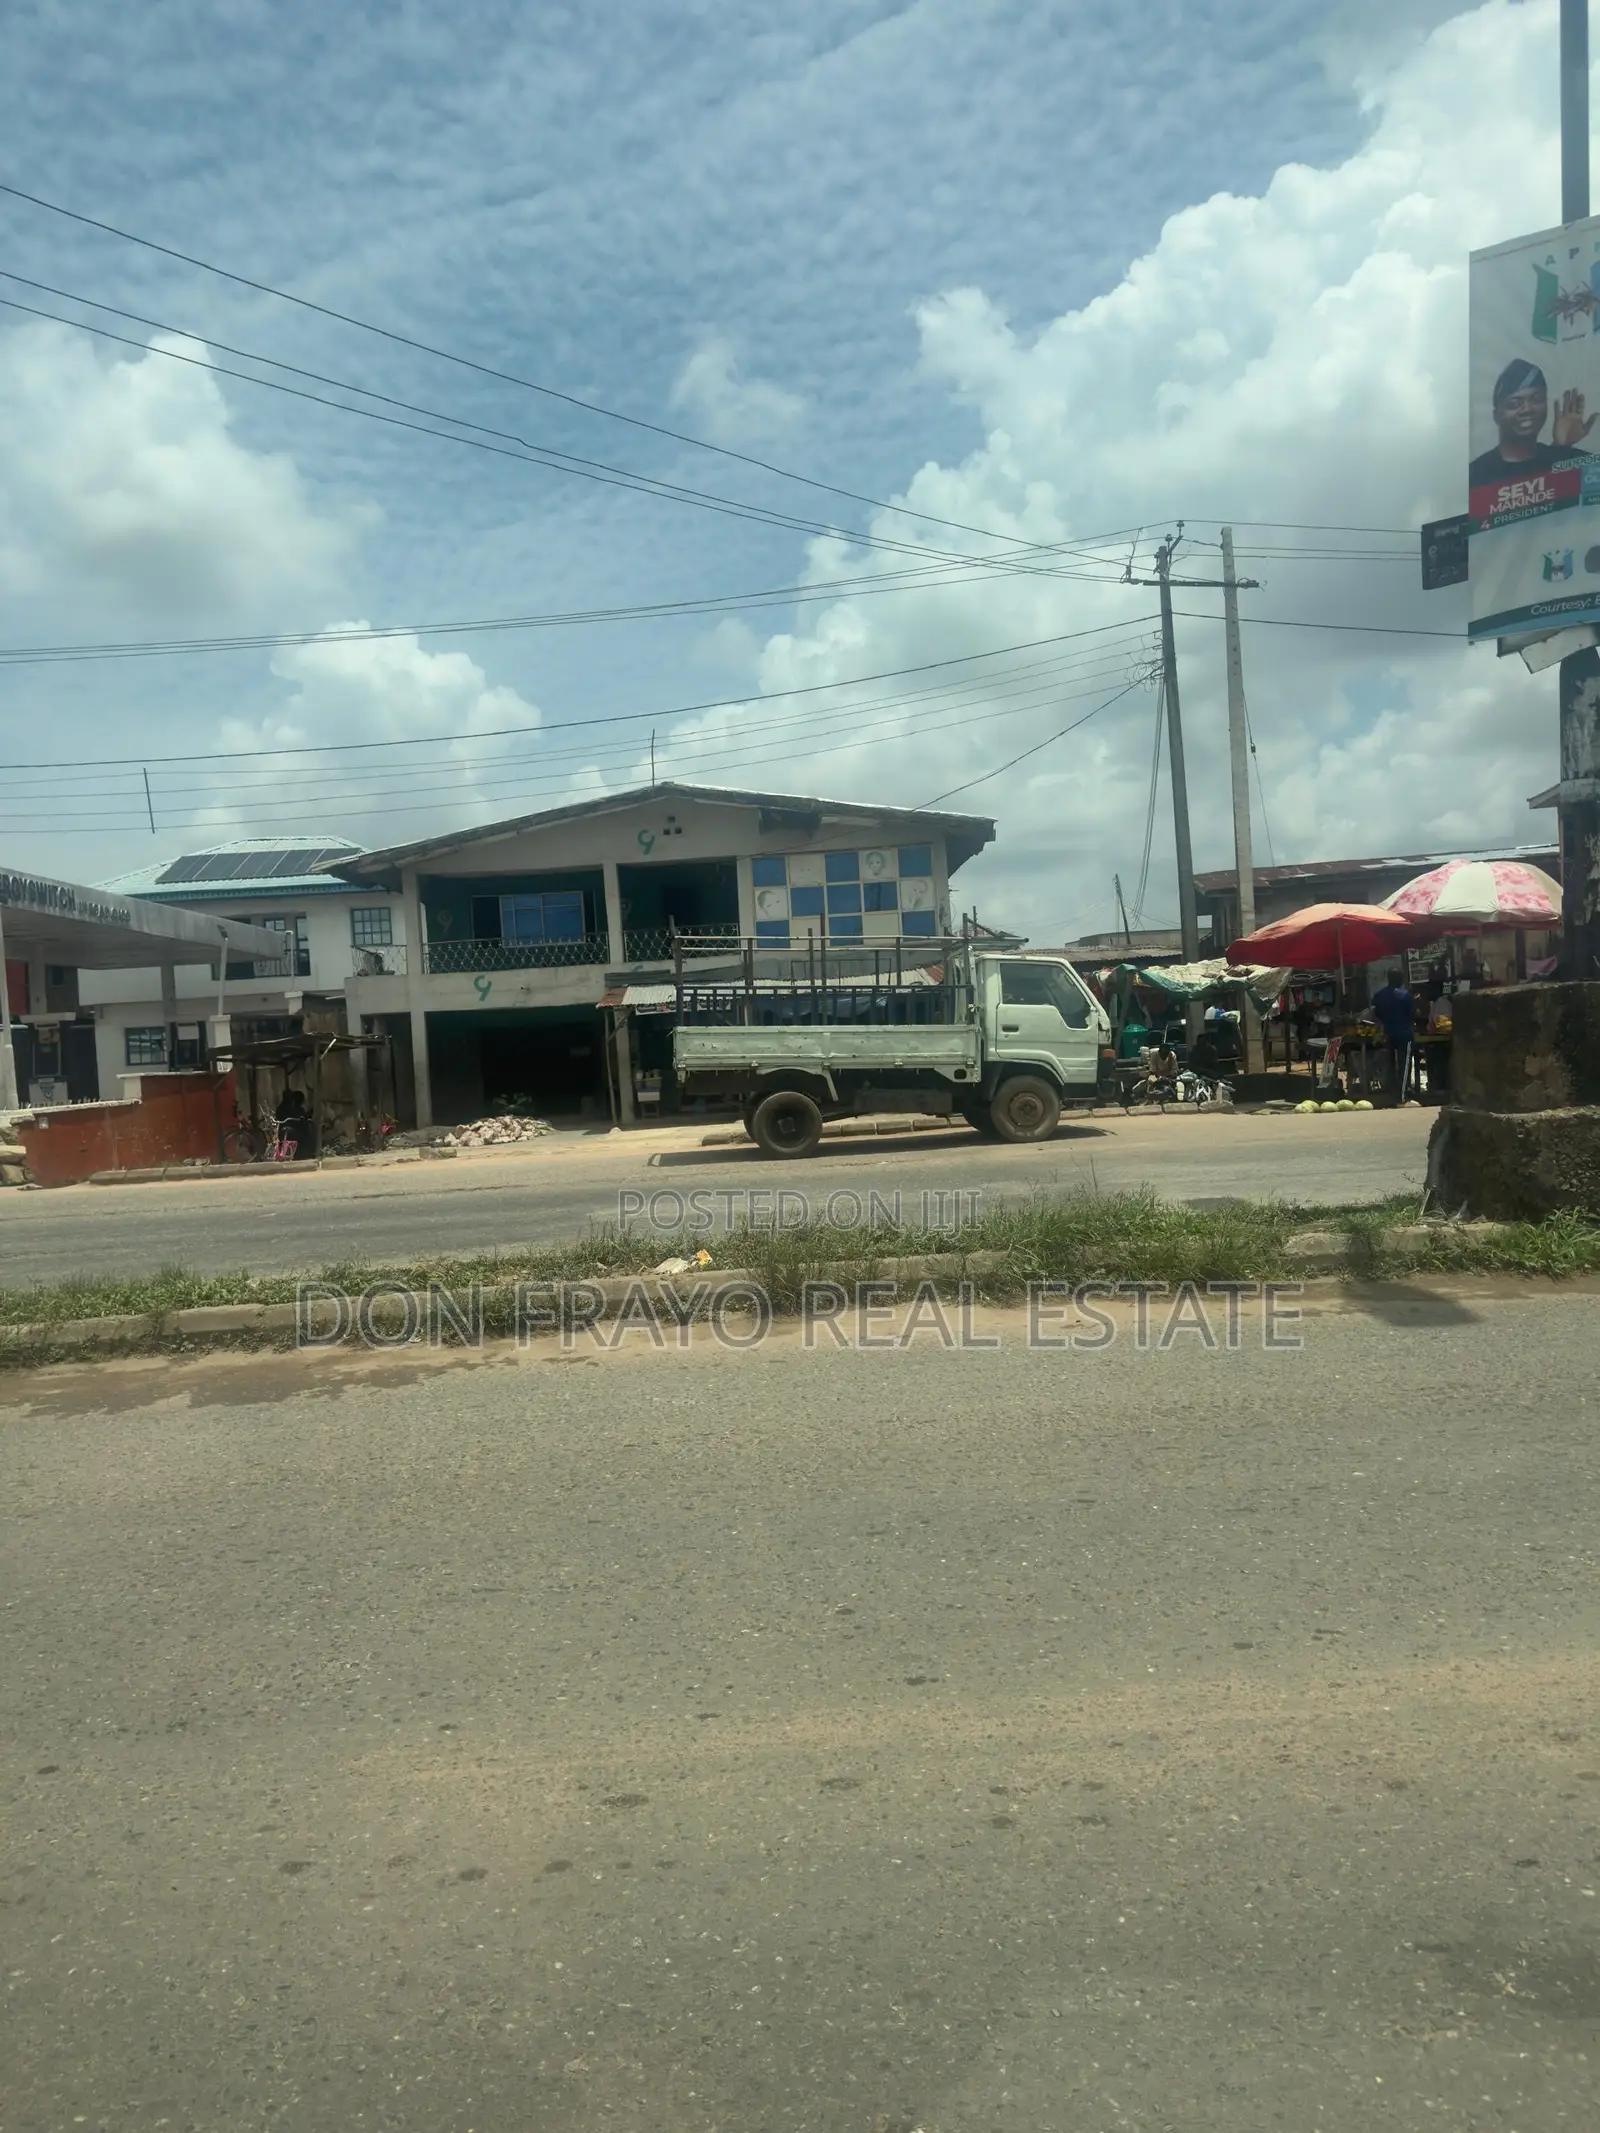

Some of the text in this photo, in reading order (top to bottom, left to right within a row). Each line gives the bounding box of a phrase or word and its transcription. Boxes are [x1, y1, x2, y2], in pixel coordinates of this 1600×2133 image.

[1489, 488, 1556, 516] MAKINDE
[1497, 476, 1546, 503] SEYI
[1494, 503, 1555, 526] PRESIDENT
[1530, 597, 1592, 615] Courtesy:
